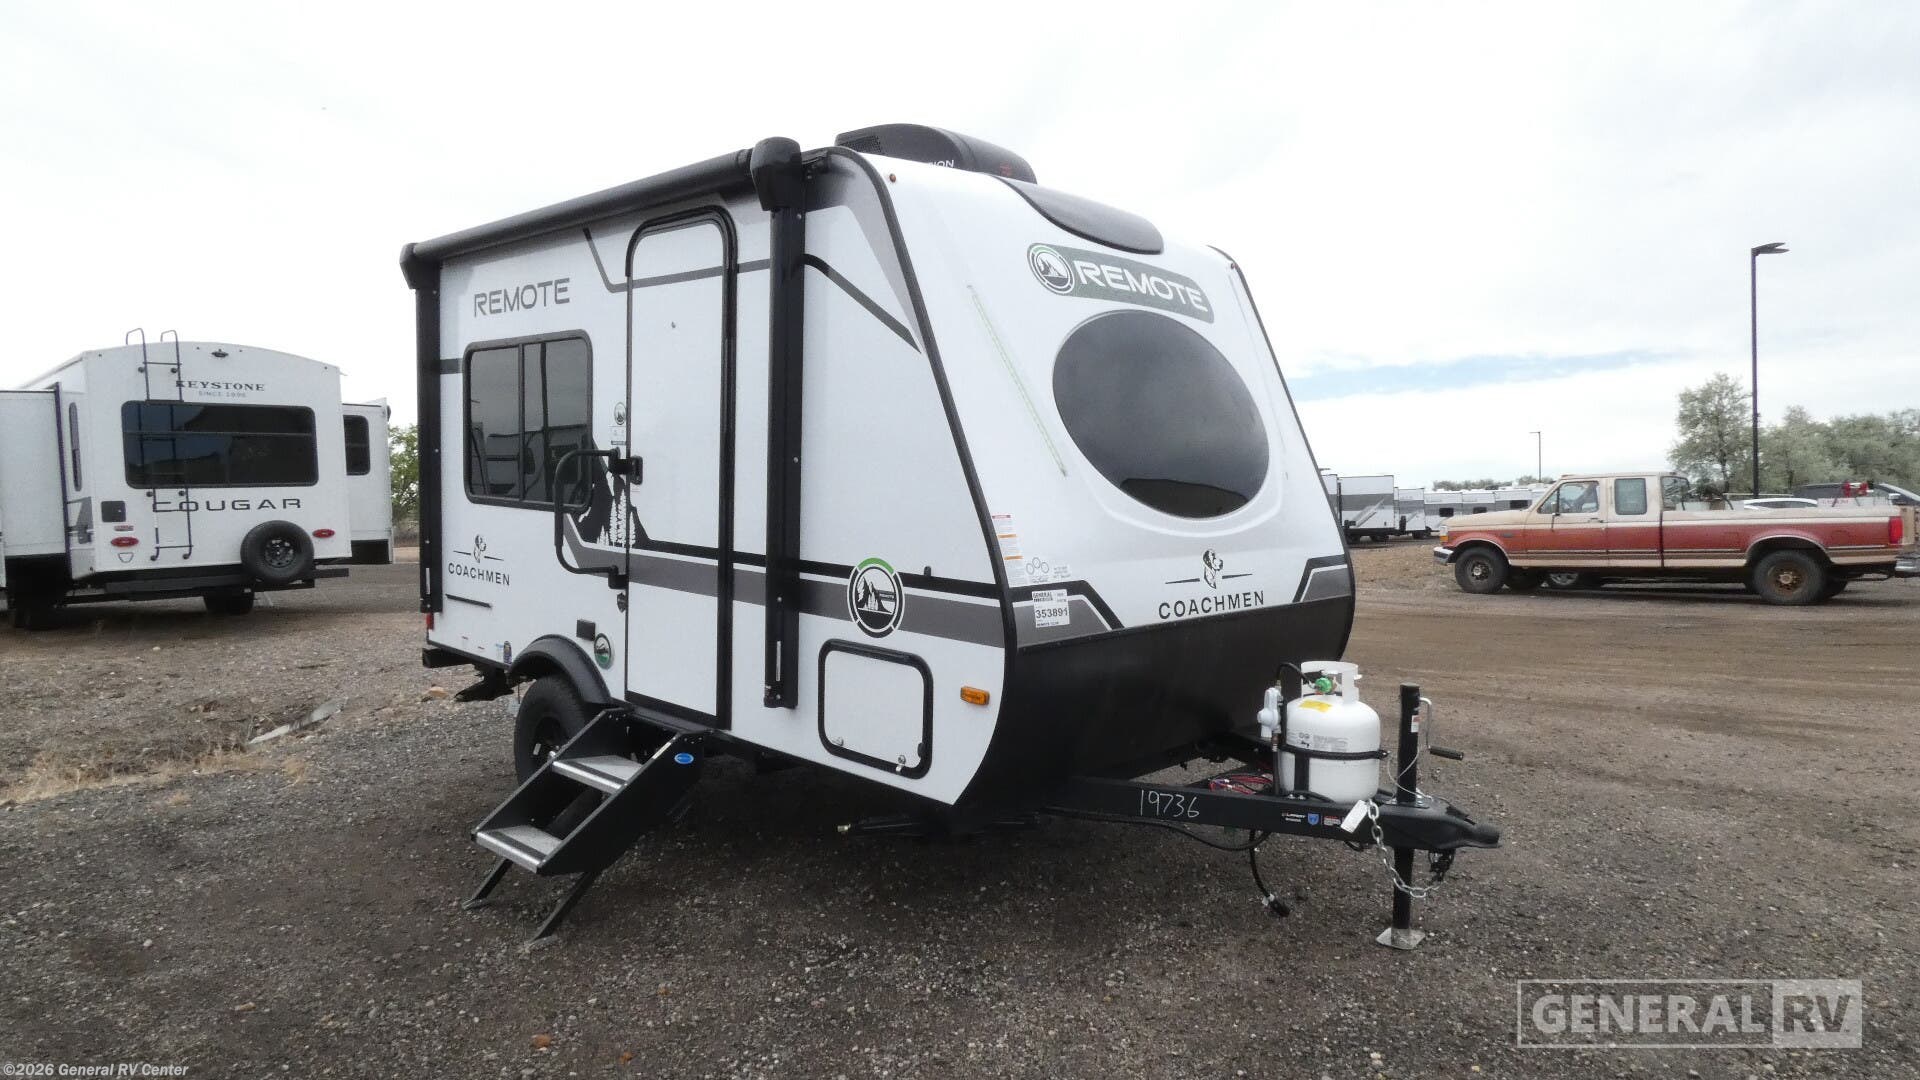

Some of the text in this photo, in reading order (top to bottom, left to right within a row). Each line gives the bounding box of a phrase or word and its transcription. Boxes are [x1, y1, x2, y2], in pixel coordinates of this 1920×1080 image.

[474, 278, 570, 316] REMOTE
[1075, 260, 1209, 312] REMOTE
[176, 381, 265, 391] KEYSTONE
[152, 497, 301, 512] COUGAR
[448, 562, 510, 586] COACHMEN
[1035, 607, 1068, 619] 353891
[1158, 590, 1265, 620] COACHMEN
[1139, 789, 1200, 819] 19736
